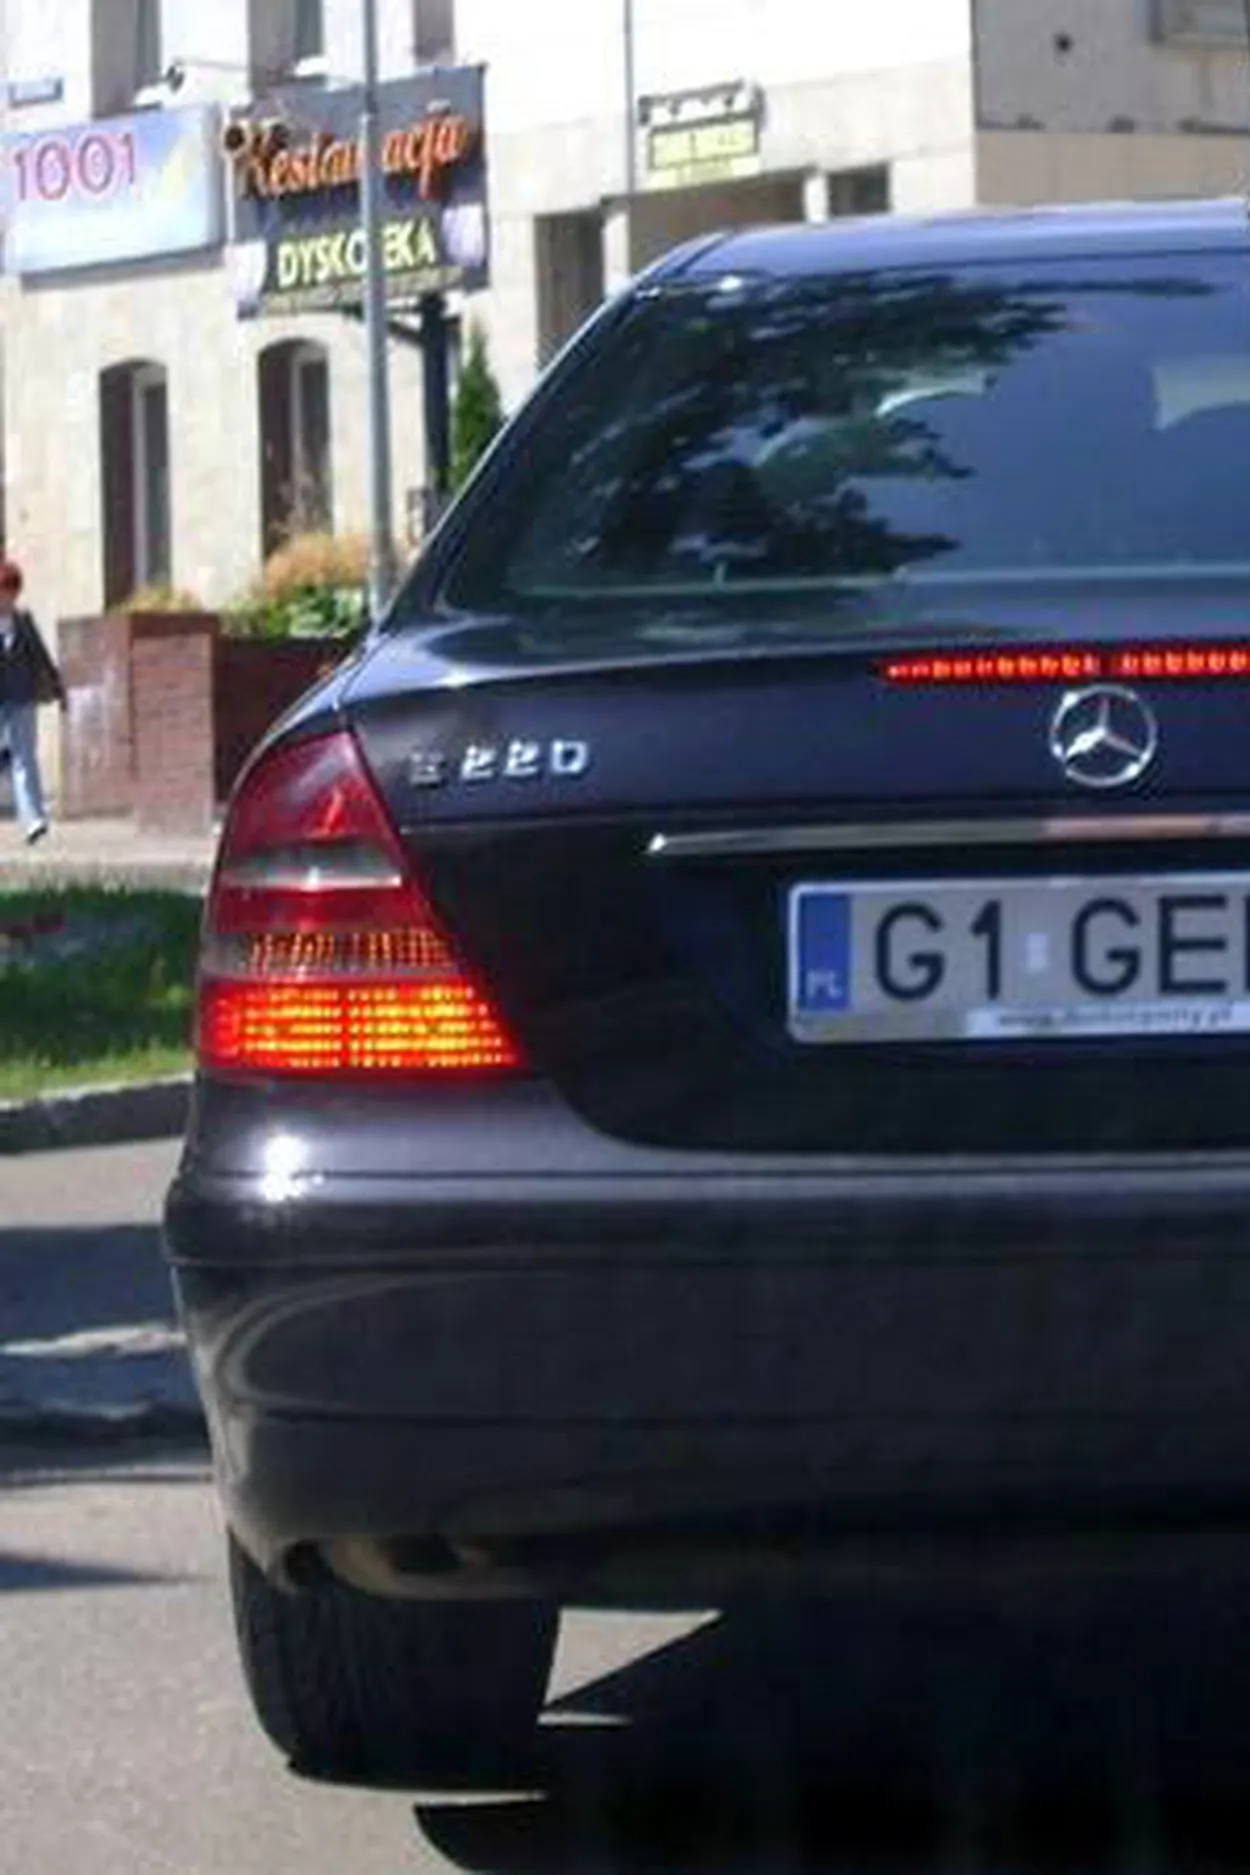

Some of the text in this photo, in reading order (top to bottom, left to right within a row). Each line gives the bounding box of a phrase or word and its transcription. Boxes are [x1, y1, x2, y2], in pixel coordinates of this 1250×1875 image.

[13, 132, 135, 200] 1001
[222, 113, 469, 199] Restauacja
[276, 217, 437, 290] DYSKOEKA
[874, 899, 1001, 1002] G1
